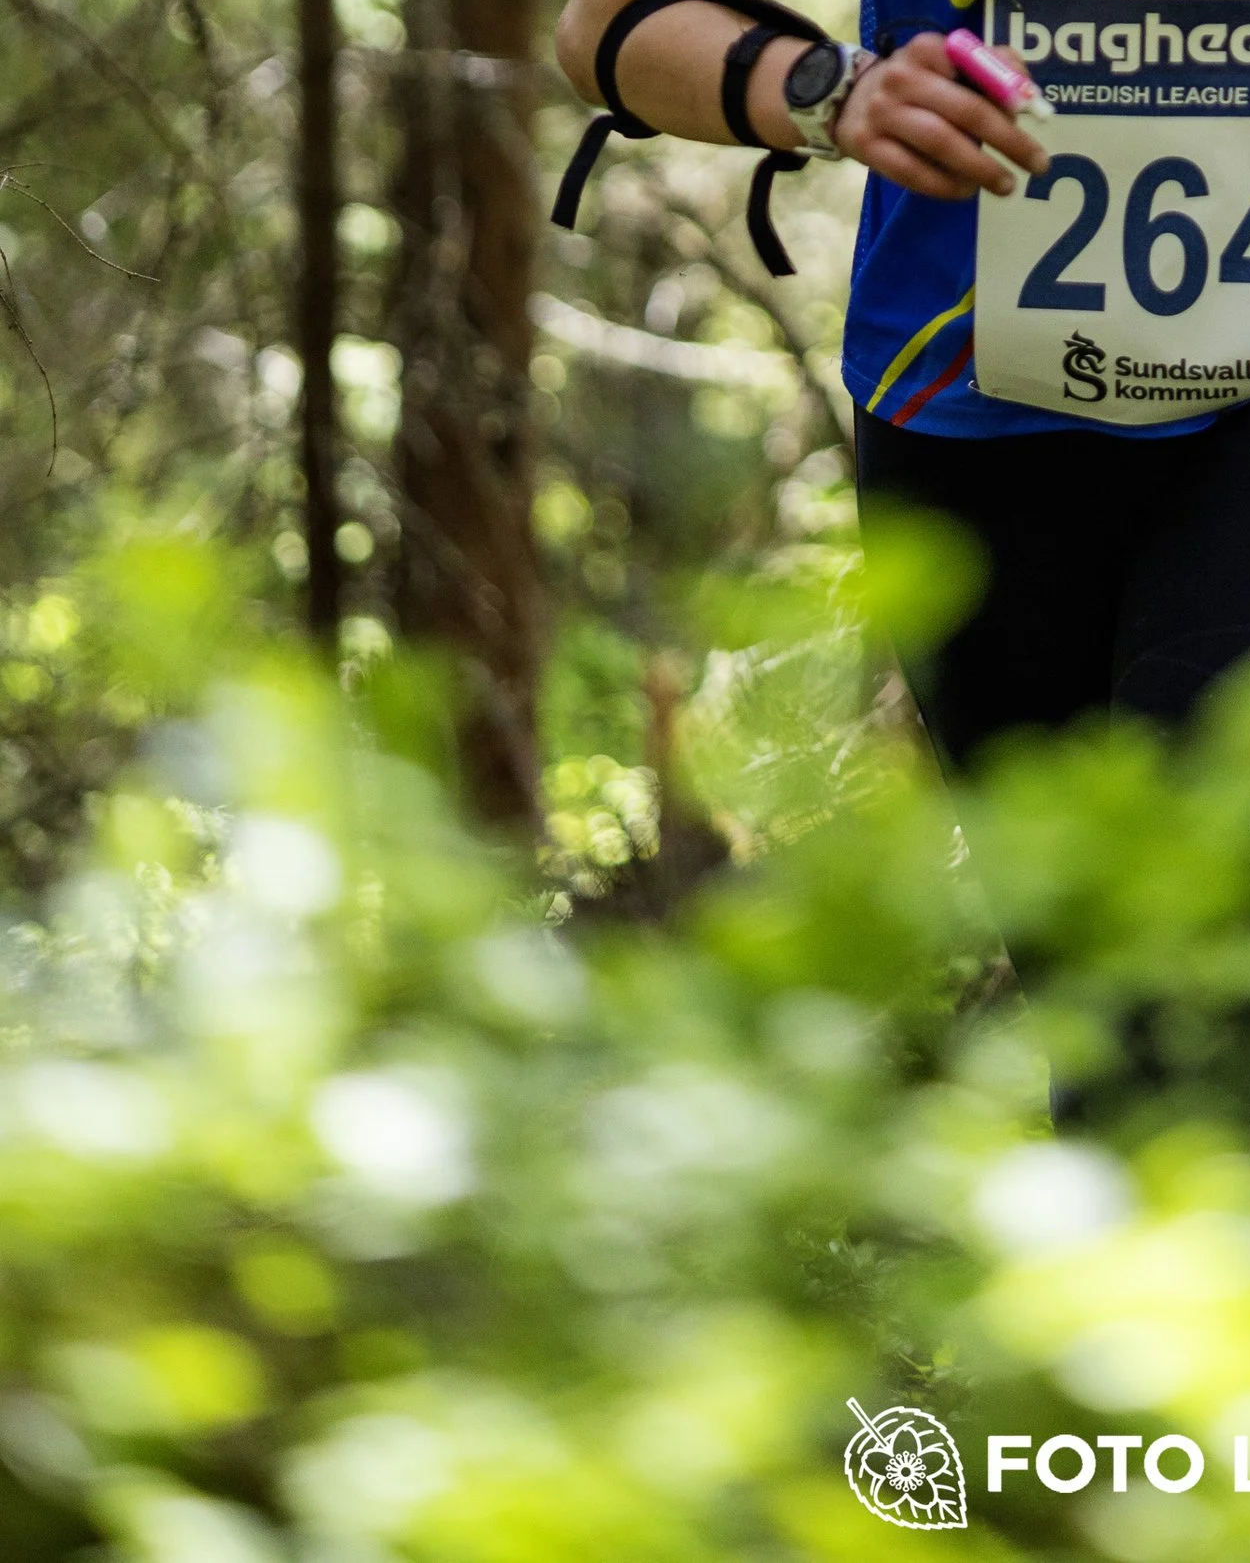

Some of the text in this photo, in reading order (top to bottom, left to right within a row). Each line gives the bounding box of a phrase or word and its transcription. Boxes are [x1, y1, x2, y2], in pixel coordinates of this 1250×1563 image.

[1045, 83, 1150, 105] SWEDISH
[1157, 86, 1248, 106] LEAGUE
[1114, 381, 1239, 402] kommun
